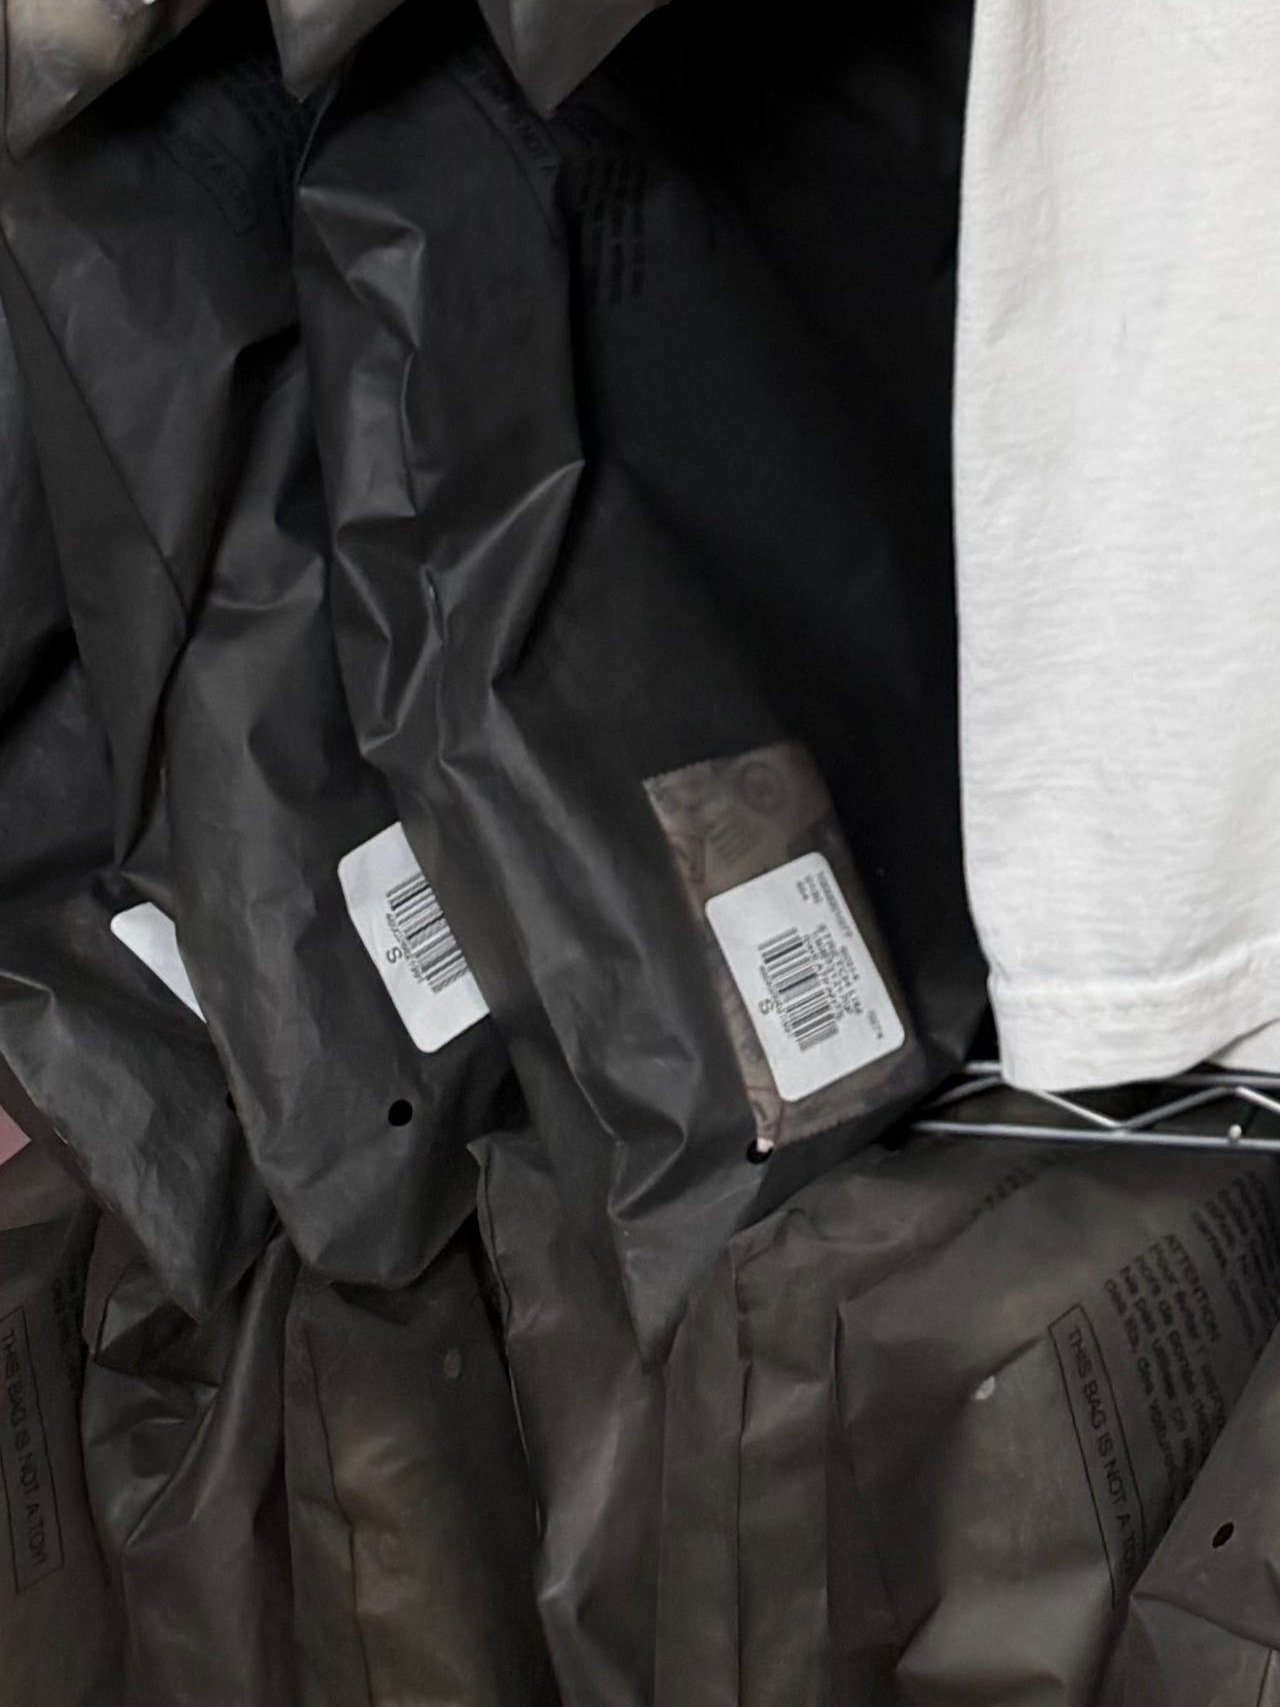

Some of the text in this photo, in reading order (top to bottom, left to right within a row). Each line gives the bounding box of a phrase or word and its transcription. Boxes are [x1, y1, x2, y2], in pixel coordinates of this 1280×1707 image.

[383, 944, 405, 966] S
[756, 997, 776, 1017] S
[1082, 1380, 1107, 1430] BAG
[1093, 1433, 1115, 1458] IS
[19, 1452, 40, 1495] NOT
[1103, 1458, 1128, 1515] NOT
